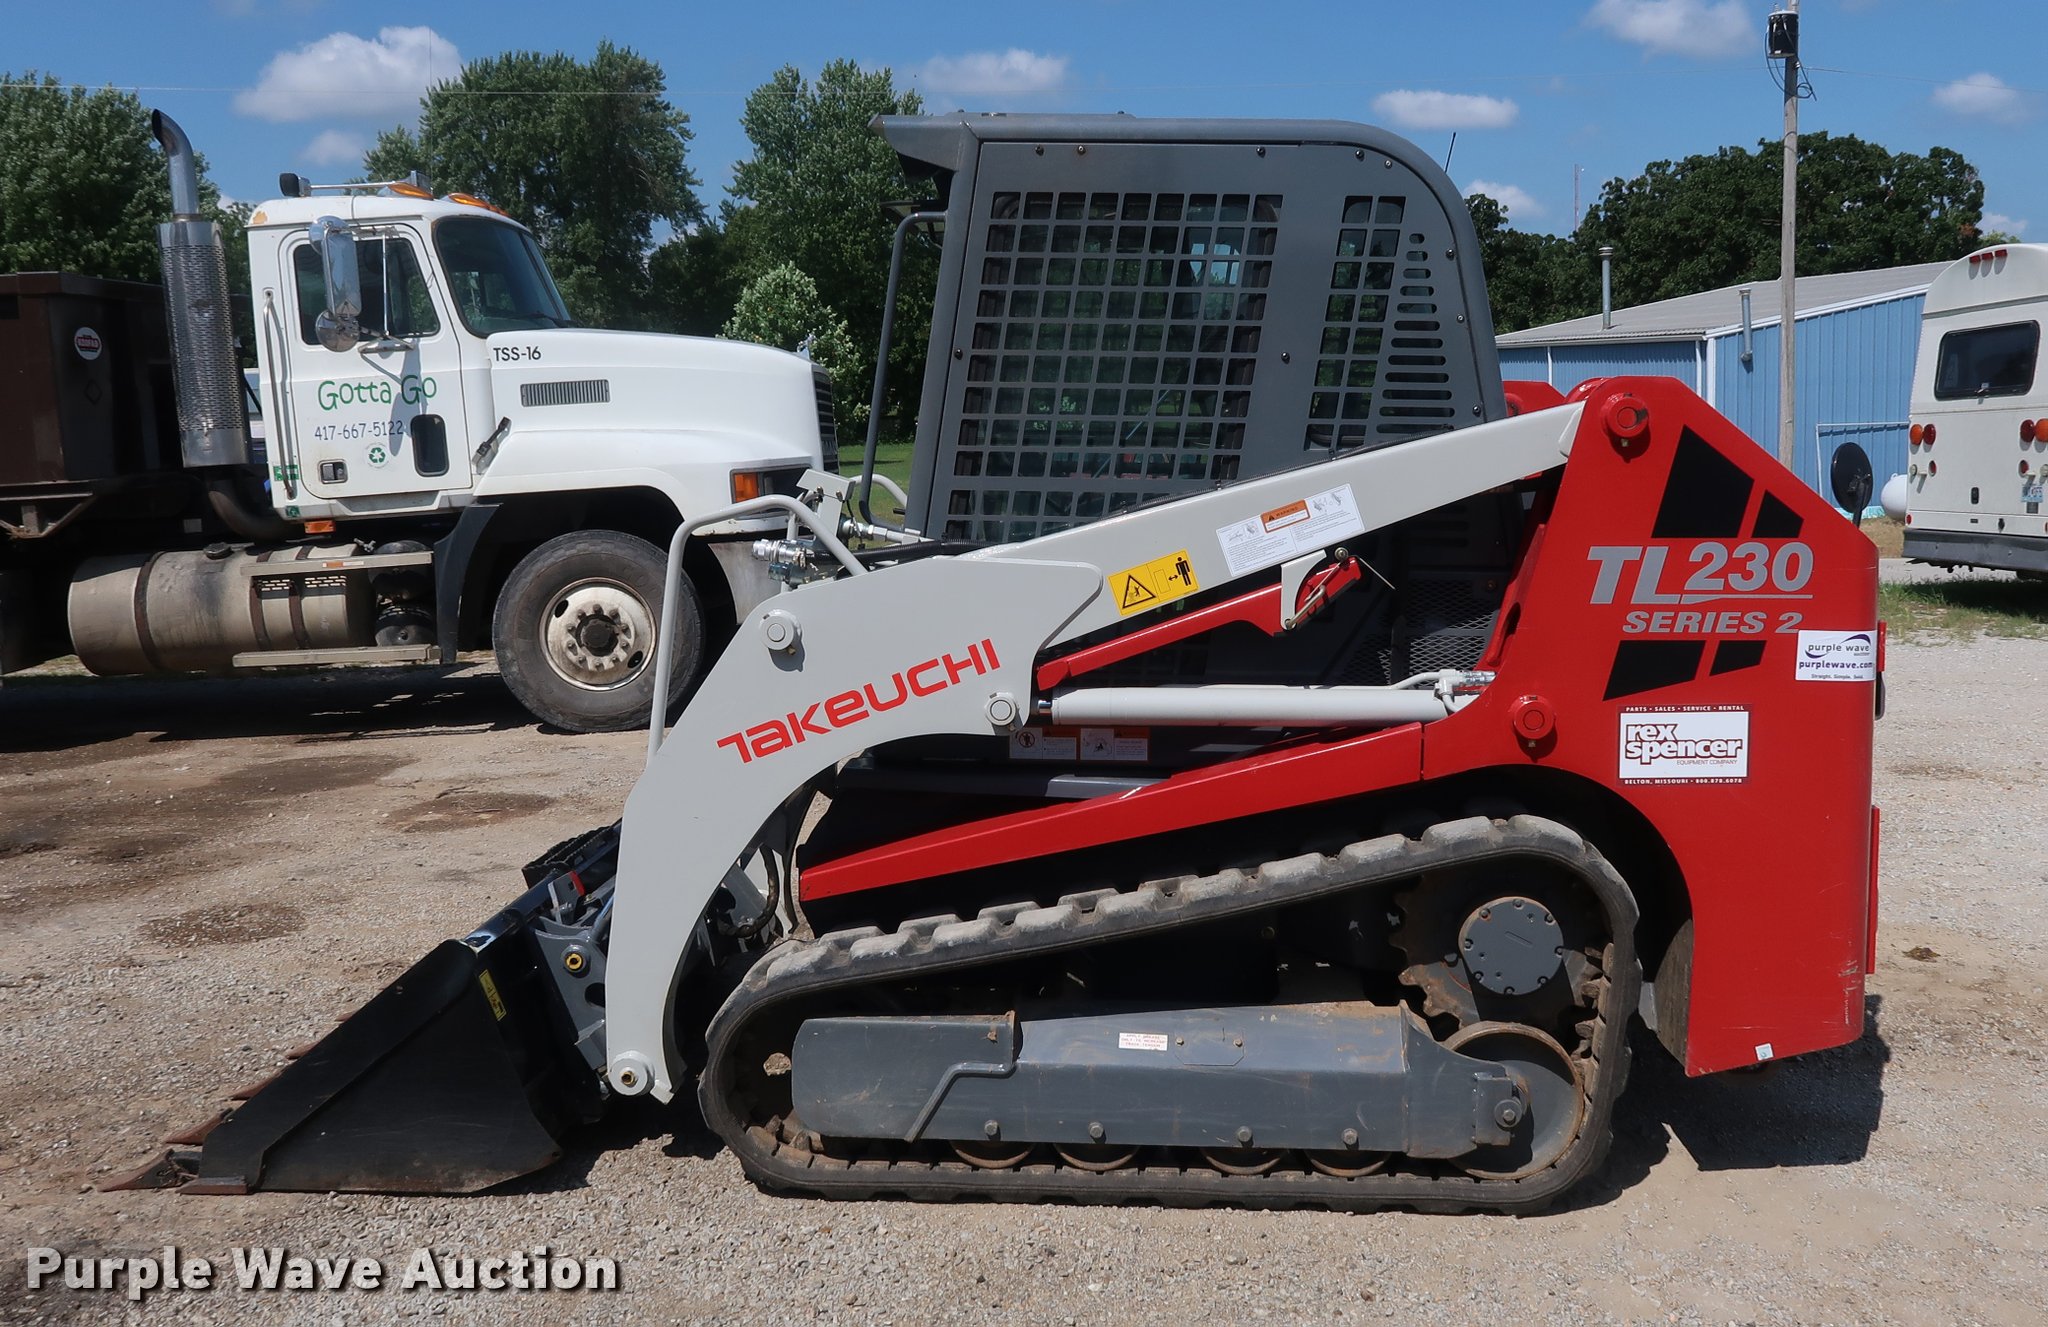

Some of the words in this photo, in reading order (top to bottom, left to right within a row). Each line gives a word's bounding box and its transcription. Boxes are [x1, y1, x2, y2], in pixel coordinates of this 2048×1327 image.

[493, 346, 541, 361] TSS-16
[318, 380, 391, 411] Gotta
[401, 374, 437, 405] Go
[314, 420, 404, 441] 417-667-5122
[1587, 541, 1814, 605] TL230
[1622, 610, 1768, 634] SERIES
[1775, 611, 1803, 634] 2
[1808, 644, 1842, 652] purple
[1799, 660, 1873, 670] purplewave.com
[1626, 724, 1678, 741] rex
[1625, 739, 1743, 765] spencer
